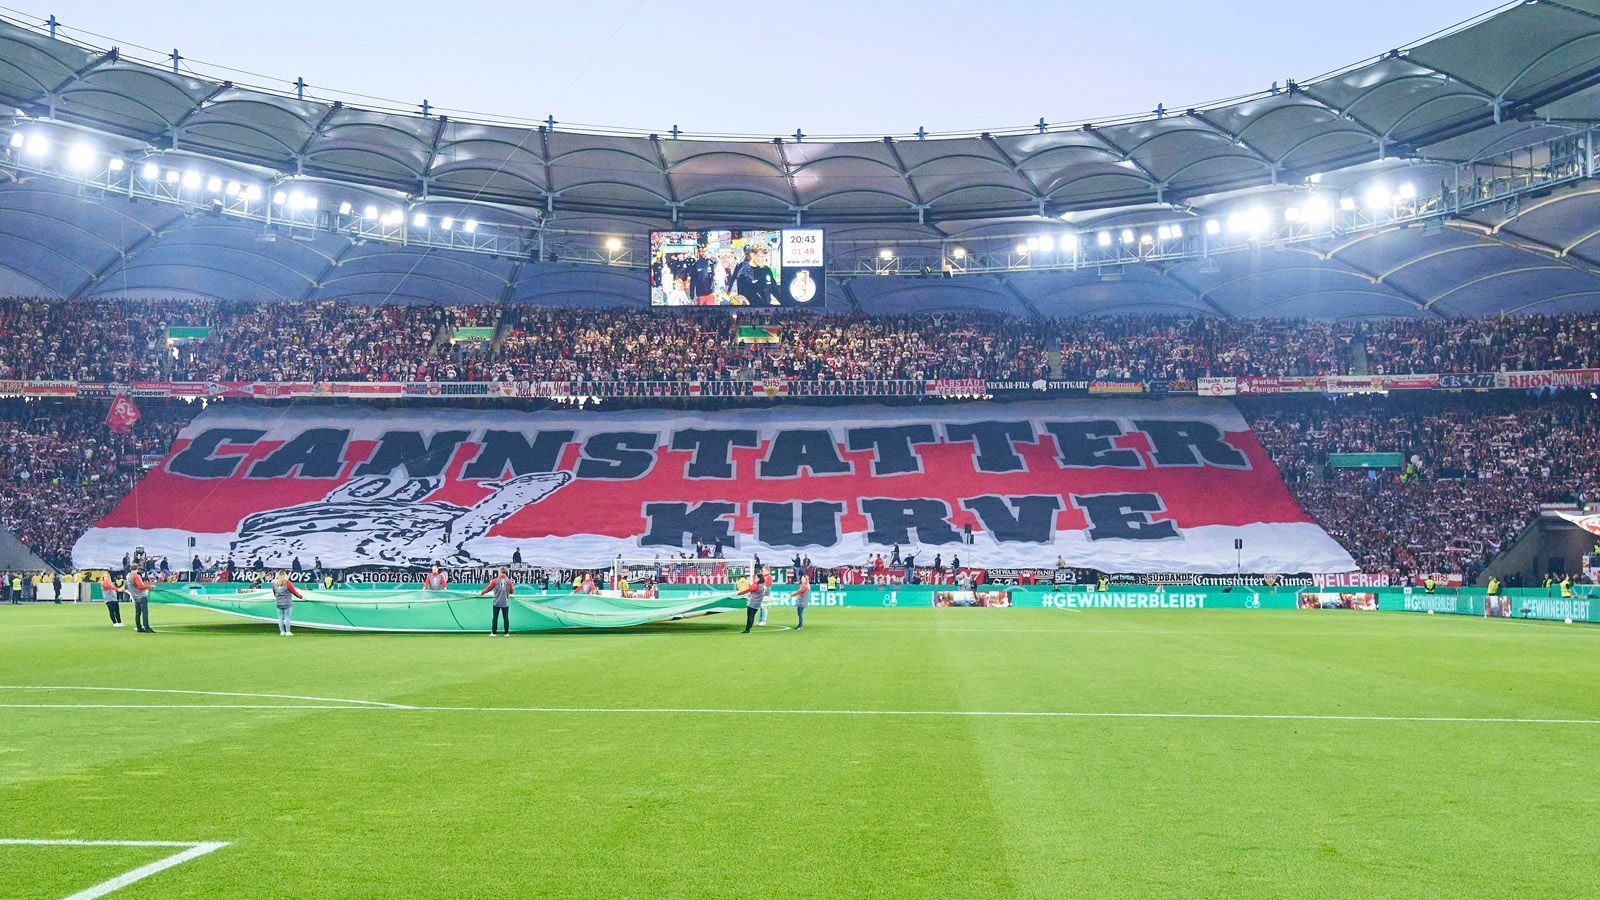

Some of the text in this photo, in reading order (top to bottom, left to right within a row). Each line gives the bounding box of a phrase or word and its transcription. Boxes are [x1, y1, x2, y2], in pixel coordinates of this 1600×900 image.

[790, 235, 816, 244] 20:43
[937, 379, 986, 387] ALBSTADT
[986, 381, 1088, 389] NECKAR-FILS STUTTGART
[1476, 374, 1492, 387] 77
[1553, 373, 1582, 385] DONAU
[441, 384, 488, 394] BERKHEIM
[570, 382, 691, 396] CANNSTATTER
[700, 382, 752, 396] KURVE
[788, 380, 926, 395] NECKARSTADION
[166, 419, 1252, 481] CANNSTATTER
[641, 492, 1184, 547] KURVE
[1194, 575, 1264, 586] Cannstatter
[1041, 593, 1206, 608] #GEWINNERBLEIBT
